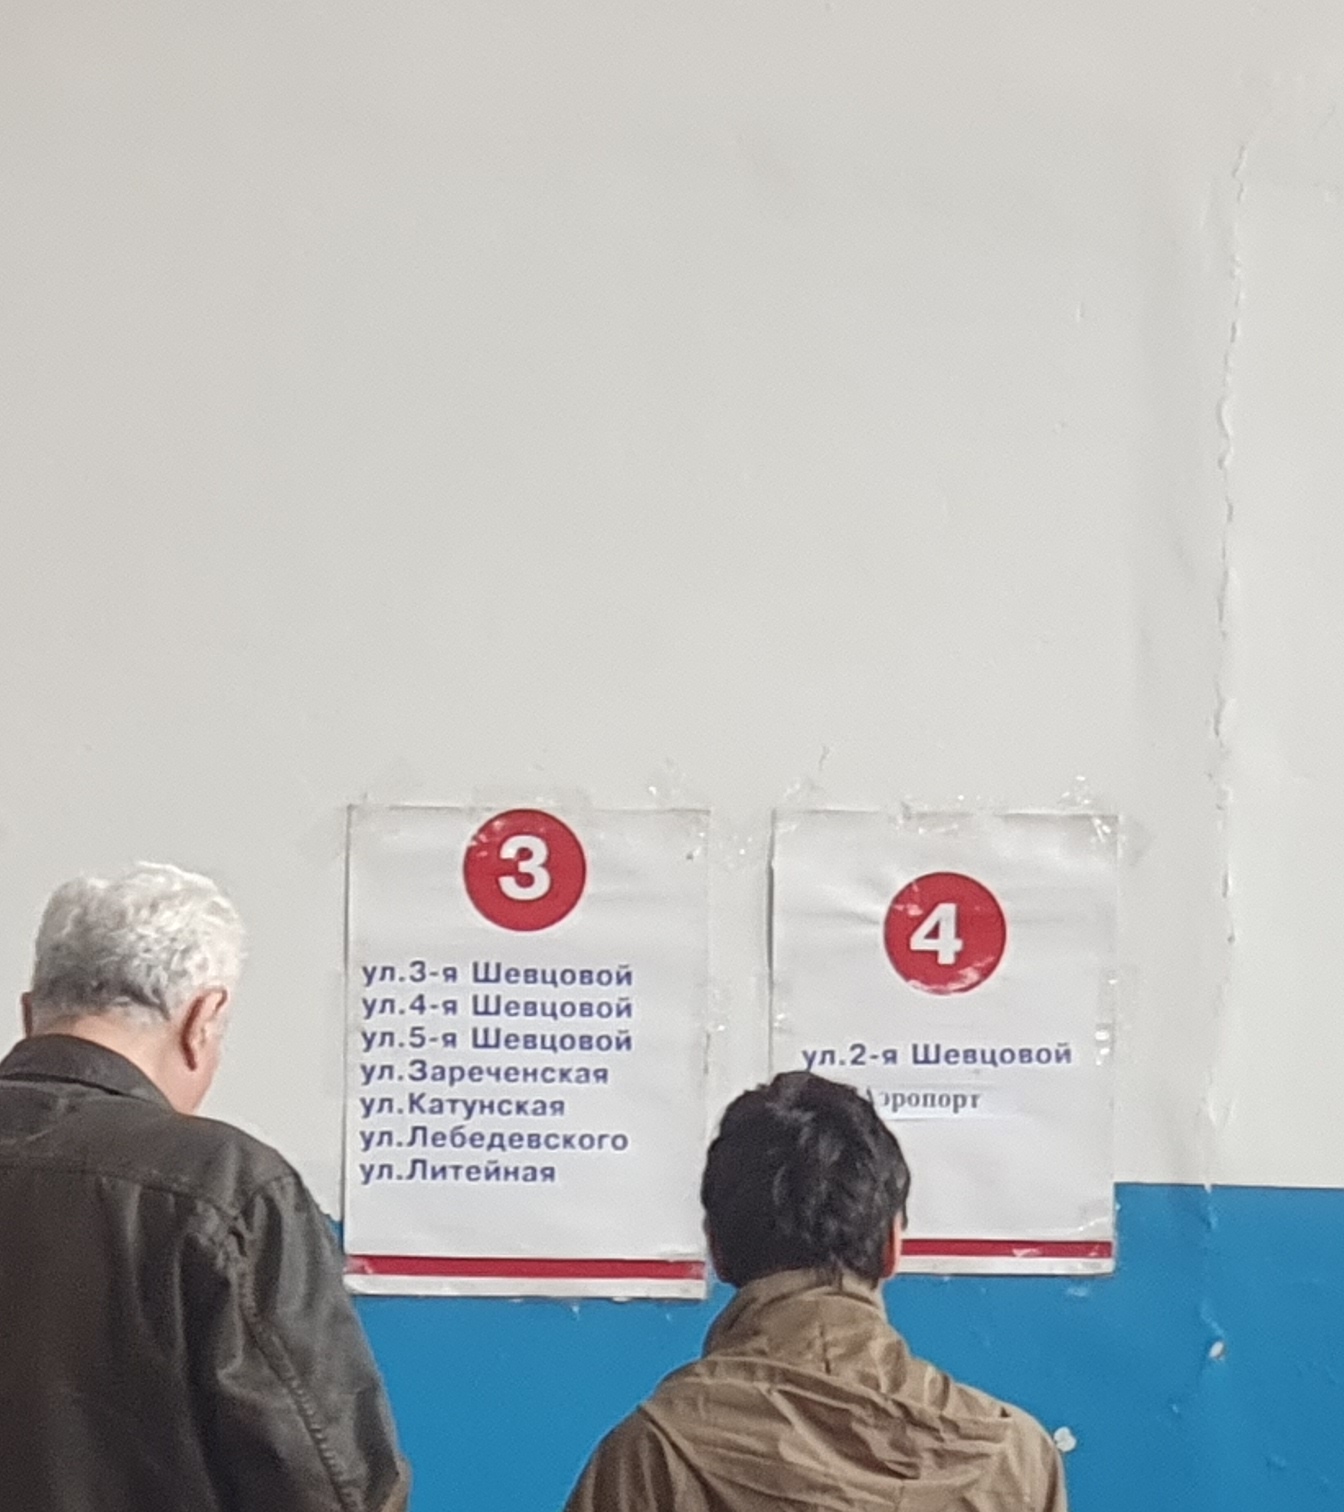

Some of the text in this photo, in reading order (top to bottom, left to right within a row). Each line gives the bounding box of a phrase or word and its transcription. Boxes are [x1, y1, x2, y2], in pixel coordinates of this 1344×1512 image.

[498, 834, 552, 902] 3
[909, 902, 964, 966] 4
[471, 961, 633, 989] Шевцовой
[471, 993, 633, 1022] Шевцовой
[471, 1026, 633, 1054] Шевцовой
[911, 1041, 1073, 1069] Шевцовой
